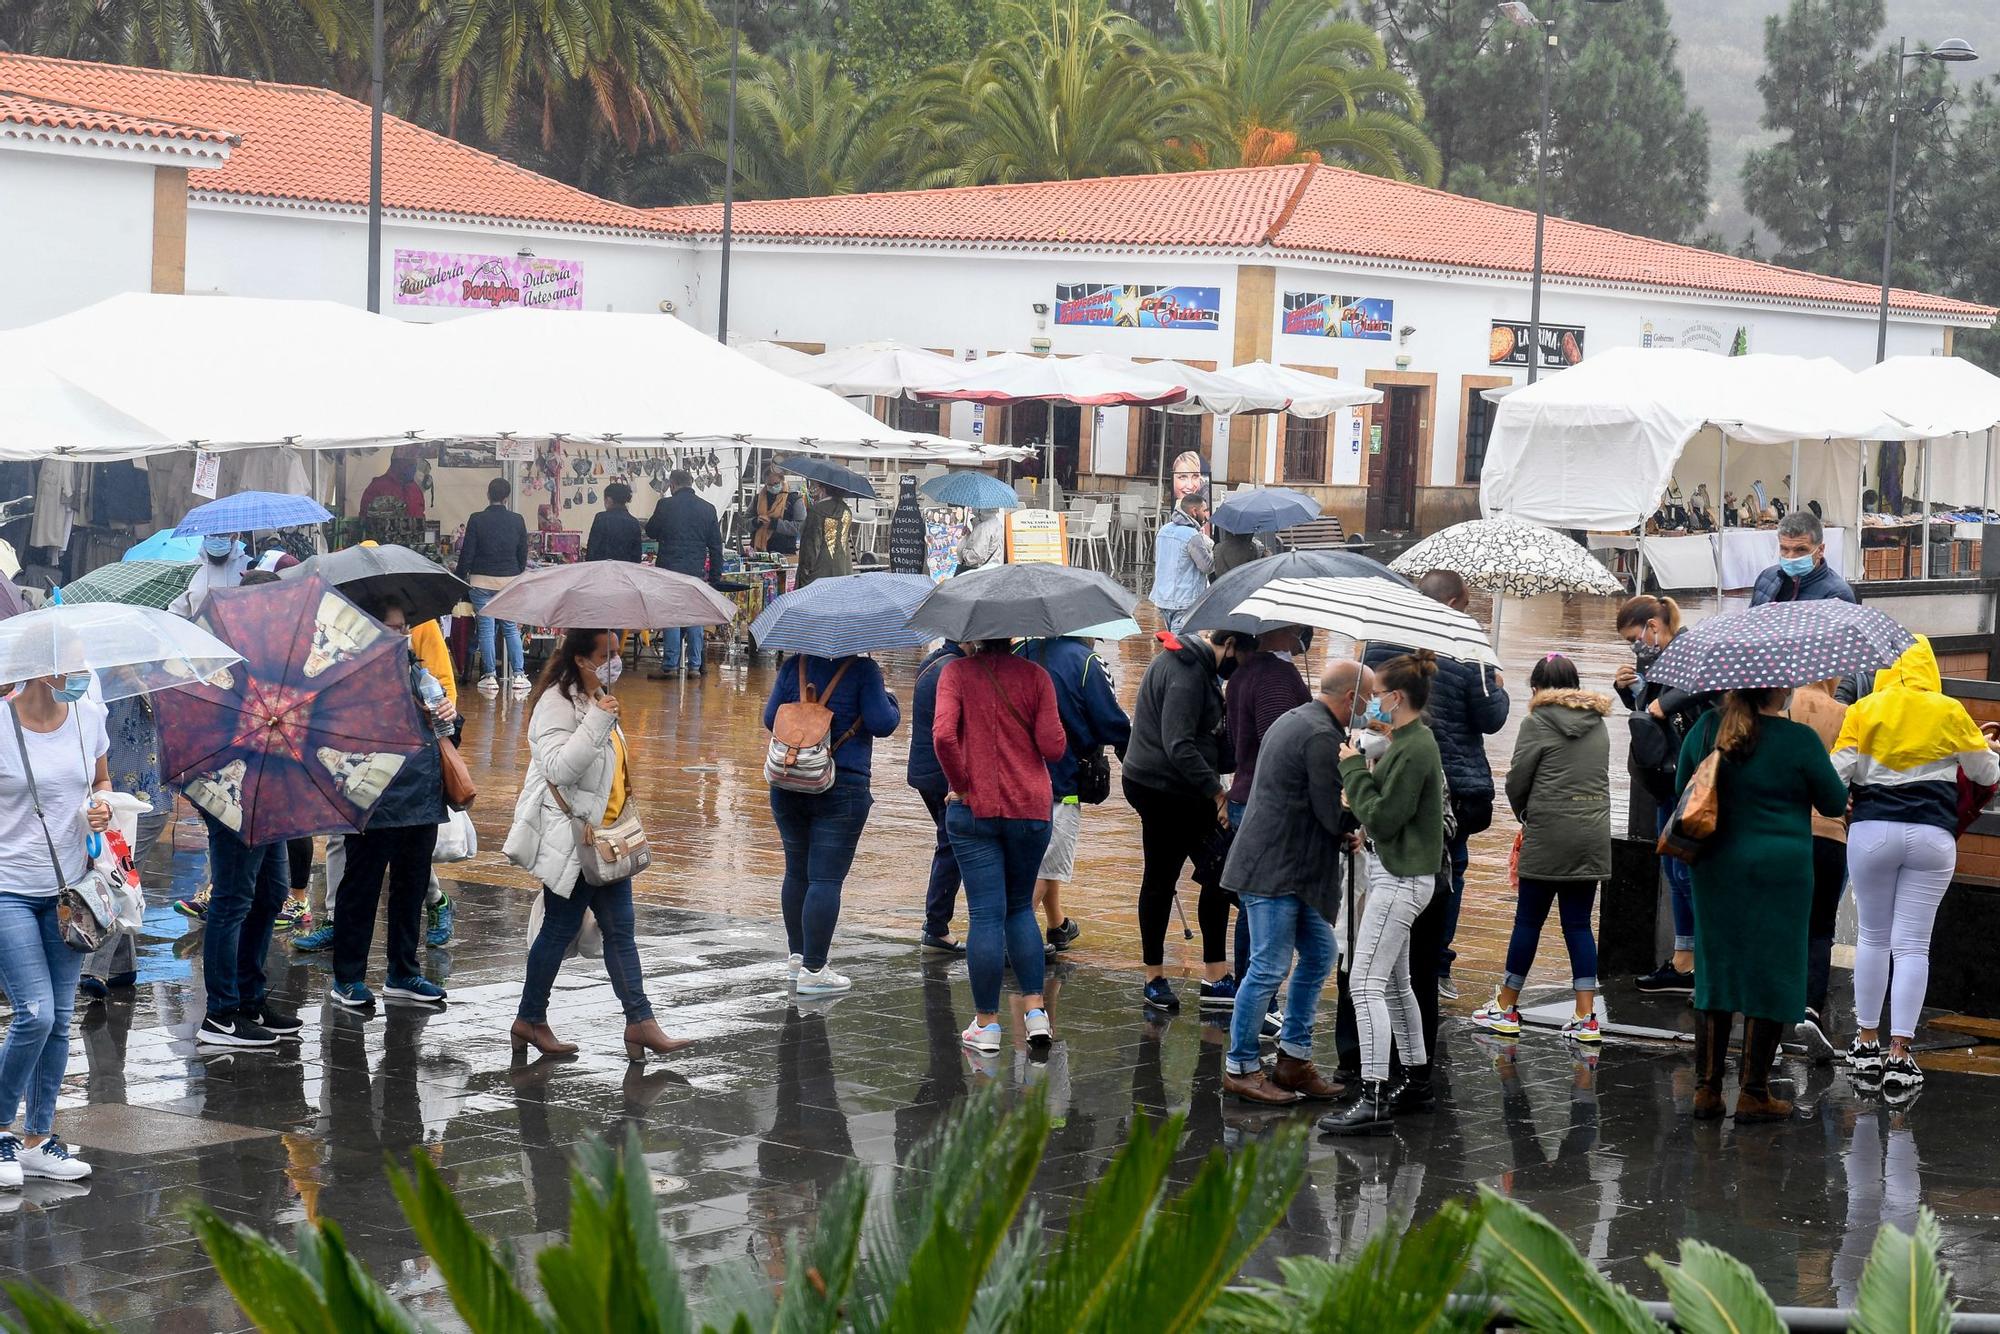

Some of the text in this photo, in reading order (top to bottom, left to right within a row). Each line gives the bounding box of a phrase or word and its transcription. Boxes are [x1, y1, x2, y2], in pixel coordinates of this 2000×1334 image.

[399, 262, 464, 297] Panadería
[523, 265, 570, 288] Dulcería
[524, 281, 578, 306] Artesanal
[1517, 329, 1529, 347] LA
